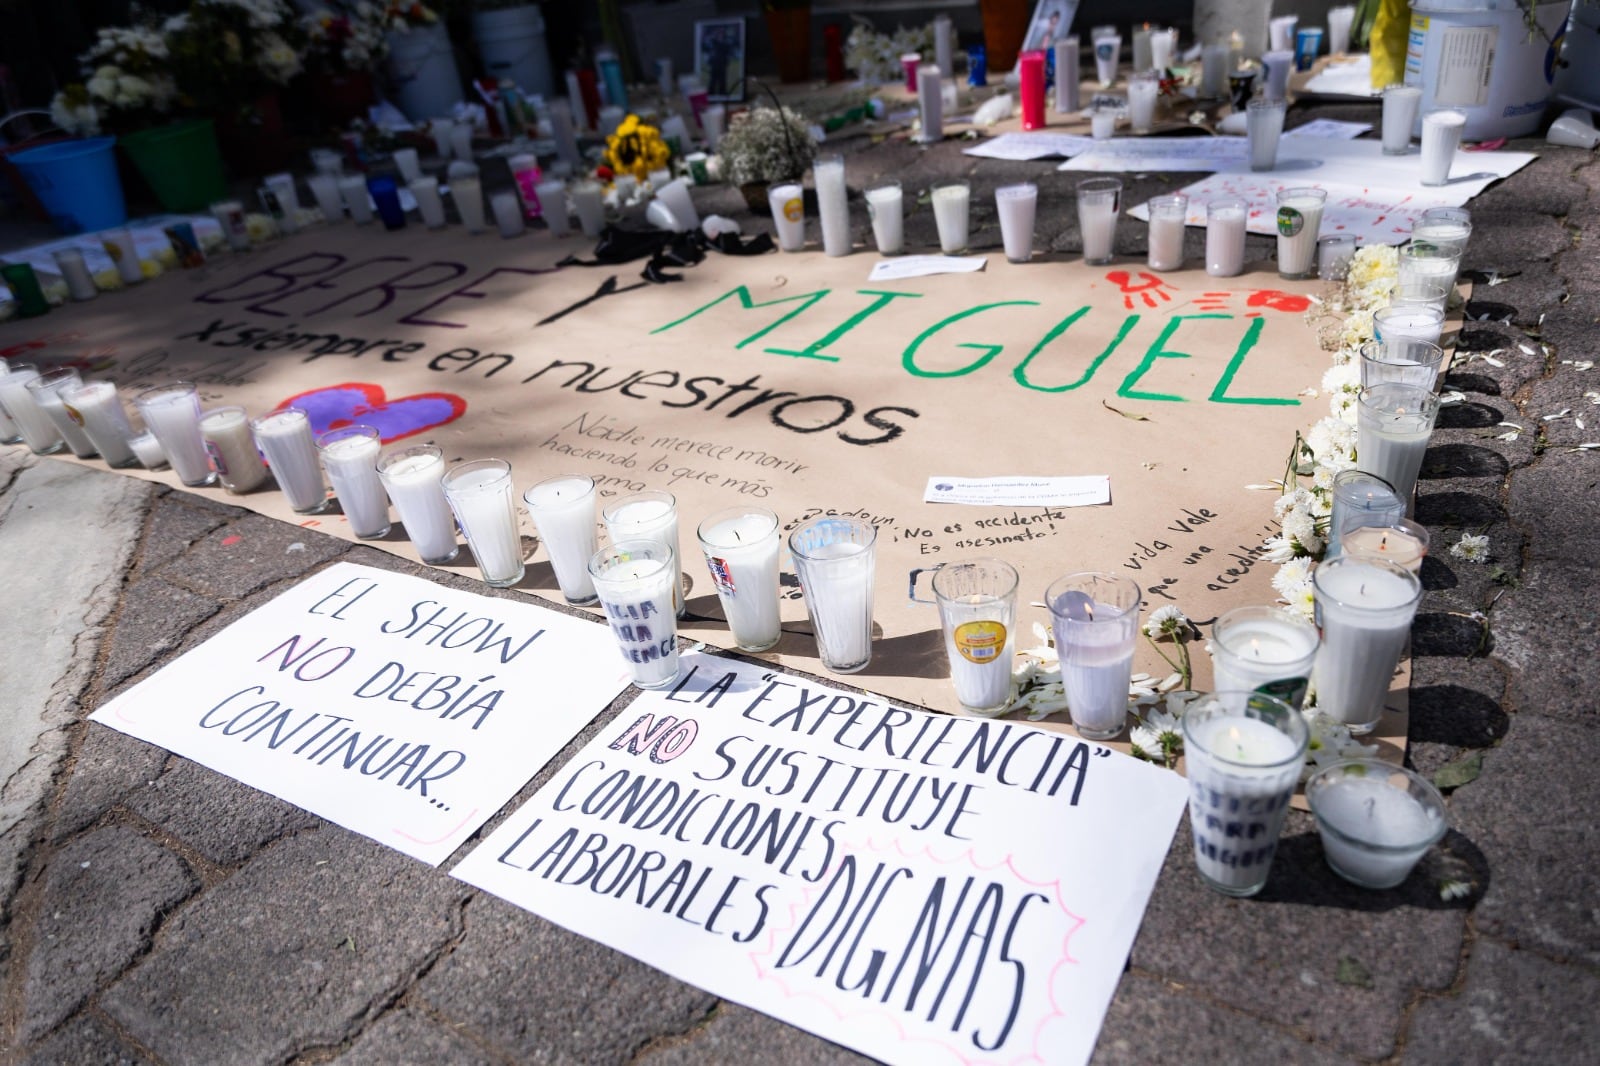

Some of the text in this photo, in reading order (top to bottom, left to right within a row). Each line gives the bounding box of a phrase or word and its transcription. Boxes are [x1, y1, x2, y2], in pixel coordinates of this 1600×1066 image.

[193, 252, 562, 328] BERE
[649, 284, 1301, 406] MIGUEL
[212, 324, 426, 364] siempre
[428, 346, 516, 378] en
[522, 358, 920, 446] nuestros
[539, 433, 773, 498] haciendo lo que más
[650, 437, 733, 461] merece
[735, 450, 809, 474] morir
[920, 523, 1058, 555] Es asesinato!
[943, 523, 963, 535] es
[975, 507, 1066, 529] accidente
[1123, 540, 1173, 570] vida
[1148, 545, 1215, 600] que una
[308, 577, 546, 664] EL SHOW
[259, 634, 506, 731] NO DEBÍA
[665, 665, 738, 708] LA
[198, 685, 467, 813] CONTINUAR...
[608, 712, 986, 840] NO SUSTITUYE
[552, 760, 846, 882] CONDICIONES
[497, 818, 1050, 1051] LABORALES DIGNAS
